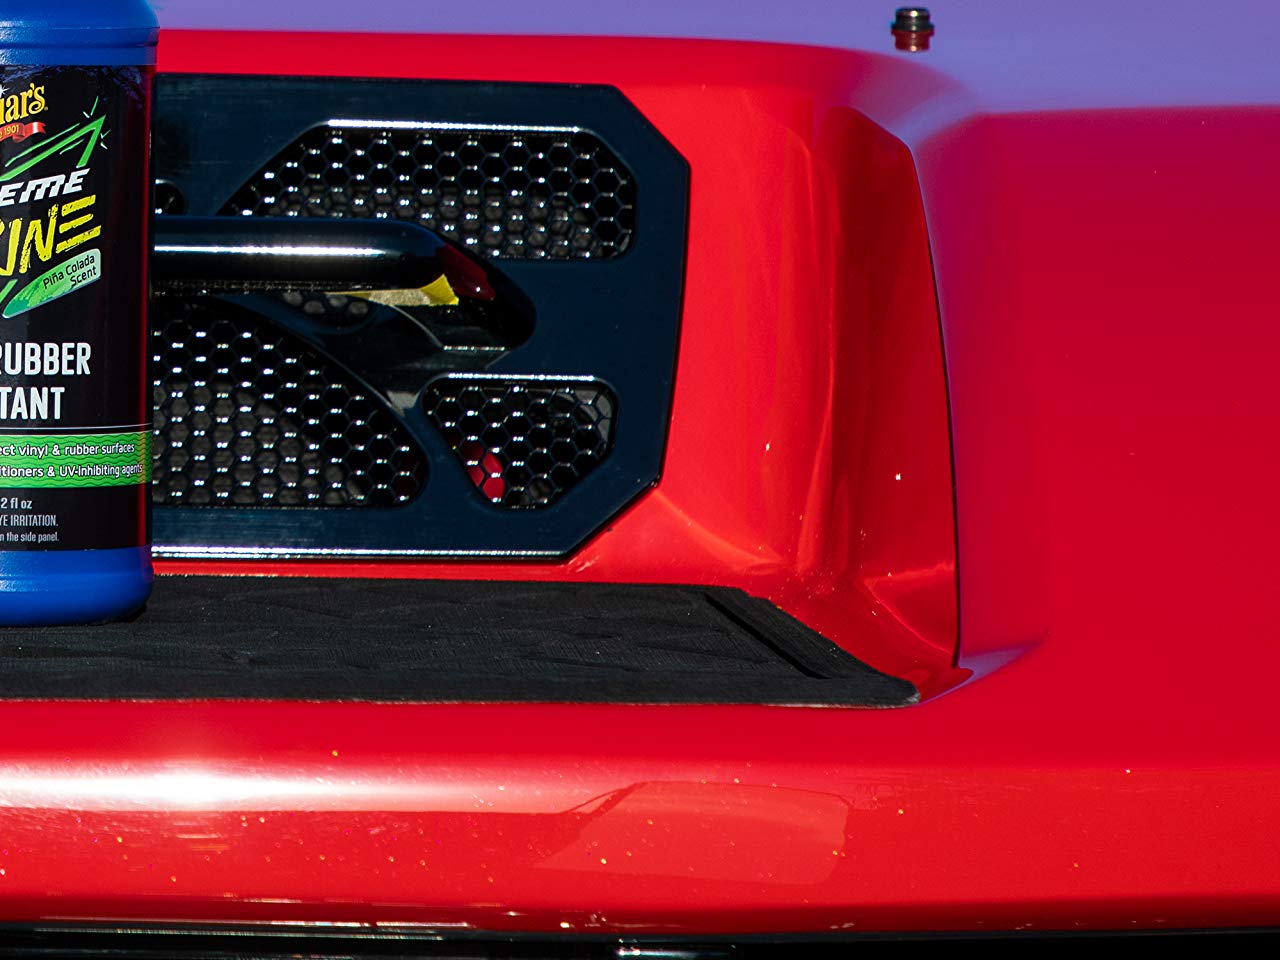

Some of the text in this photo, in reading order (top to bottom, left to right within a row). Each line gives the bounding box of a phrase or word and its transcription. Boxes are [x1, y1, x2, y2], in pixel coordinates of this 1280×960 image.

[4, 124, 20, 138] 1901
[43, 255, 95, 290] Piña Colada
[70, 266, 97, 287] Scent
[18, 444, 48, 459] vinyl
[52, 444, 61, 456] &
[65, 444, 99, 455] rubber
[101, 442, 135, 455] surfaces
[47, 466, 56, 477] &
[59, 465, 120, 478] UV-inhibiting
[121, 463, 143, 477] agents
[10, 497, 18, 510] fl
[21, 499, 33, 510] oz
[10, 514, 59, 527] IRRITATION.
[6, 531, 19, 542] the
[20, 532, 36, 542] side
[38, 532, 60, 544] panel.
